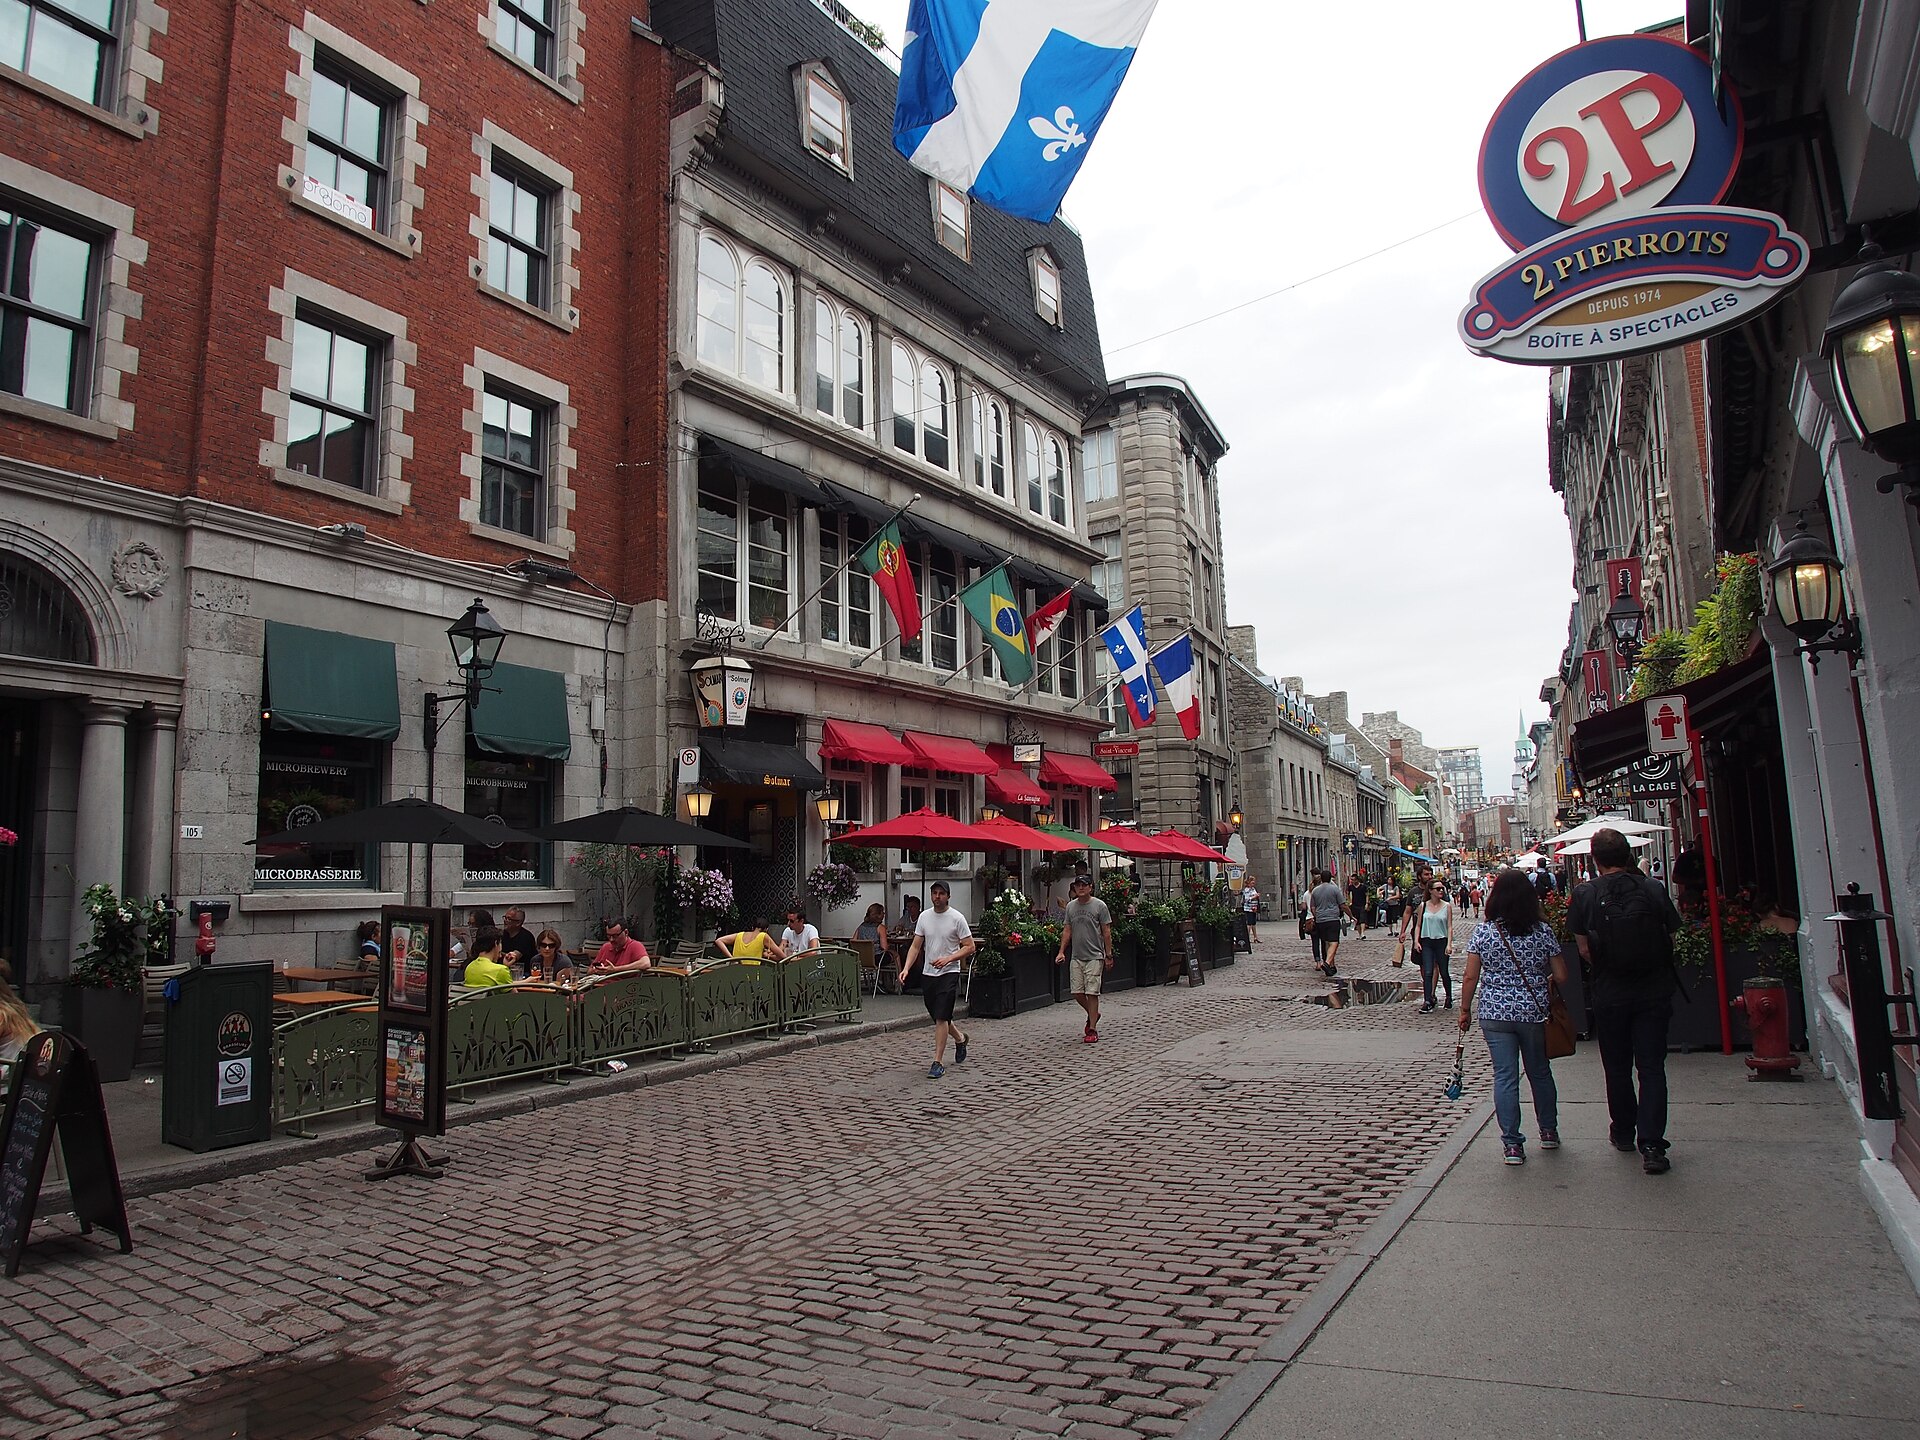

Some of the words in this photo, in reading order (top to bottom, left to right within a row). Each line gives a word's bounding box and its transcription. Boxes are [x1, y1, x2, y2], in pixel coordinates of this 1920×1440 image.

[1523, 73, 1684, 226] 2P
[323, 191, 366, 223] domo
[1521, 264, 1555, 301] 2
[1553, 230, 1729, 281] PIERROTS
[1588, 295, 1629, 315] DEPUIS
[1633, 289, 1661, 305] 1974
[1527, 332, 1584, 348] BOÎTE
[1590, 328, 1603, 345] À
[1609, 292, 1738, 342] SPECTACLES
[731, 674, 750, 684] Solmar
[266, 761, 349, 776] MICROBREWERY
[466, 777, 529, 789] MICROBREWERY
[763, 774, 790, 787] Solmar
[1633, 784, 1646, 792] LA
[1649, 782, 1677, 792] CAGE
[186, 827, 198, 837] 105
[254, 869, 362, 880] MICROBRASSERIE
[462, 870, 535, 880] ICROBRASSERIE
